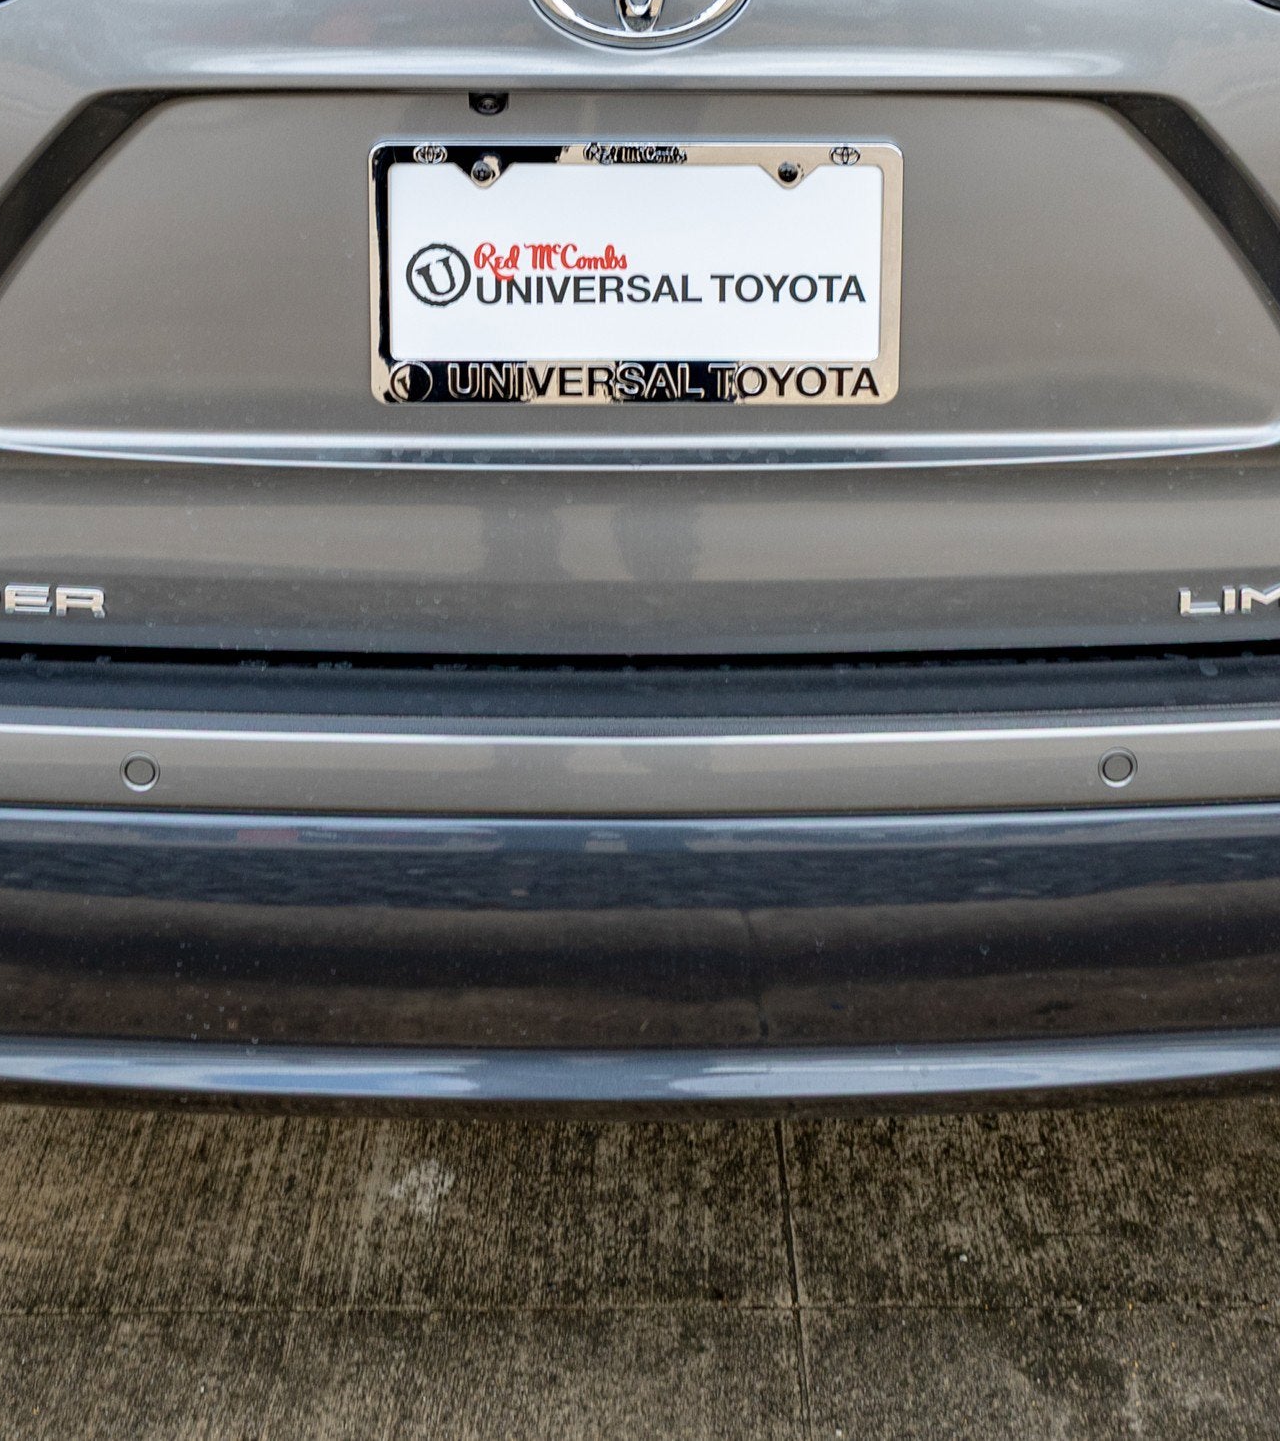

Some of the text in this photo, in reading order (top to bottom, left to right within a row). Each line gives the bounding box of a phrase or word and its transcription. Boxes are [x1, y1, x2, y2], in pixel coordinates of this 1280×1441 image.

[474, 242, 629, 282] Red McCombs
[476, 273, 867, 305] UNIVERSAL TOYOTA
[446, 361, 706, 401] UNIVERSAL
[707, 362, 881, 399] TOYOTA
